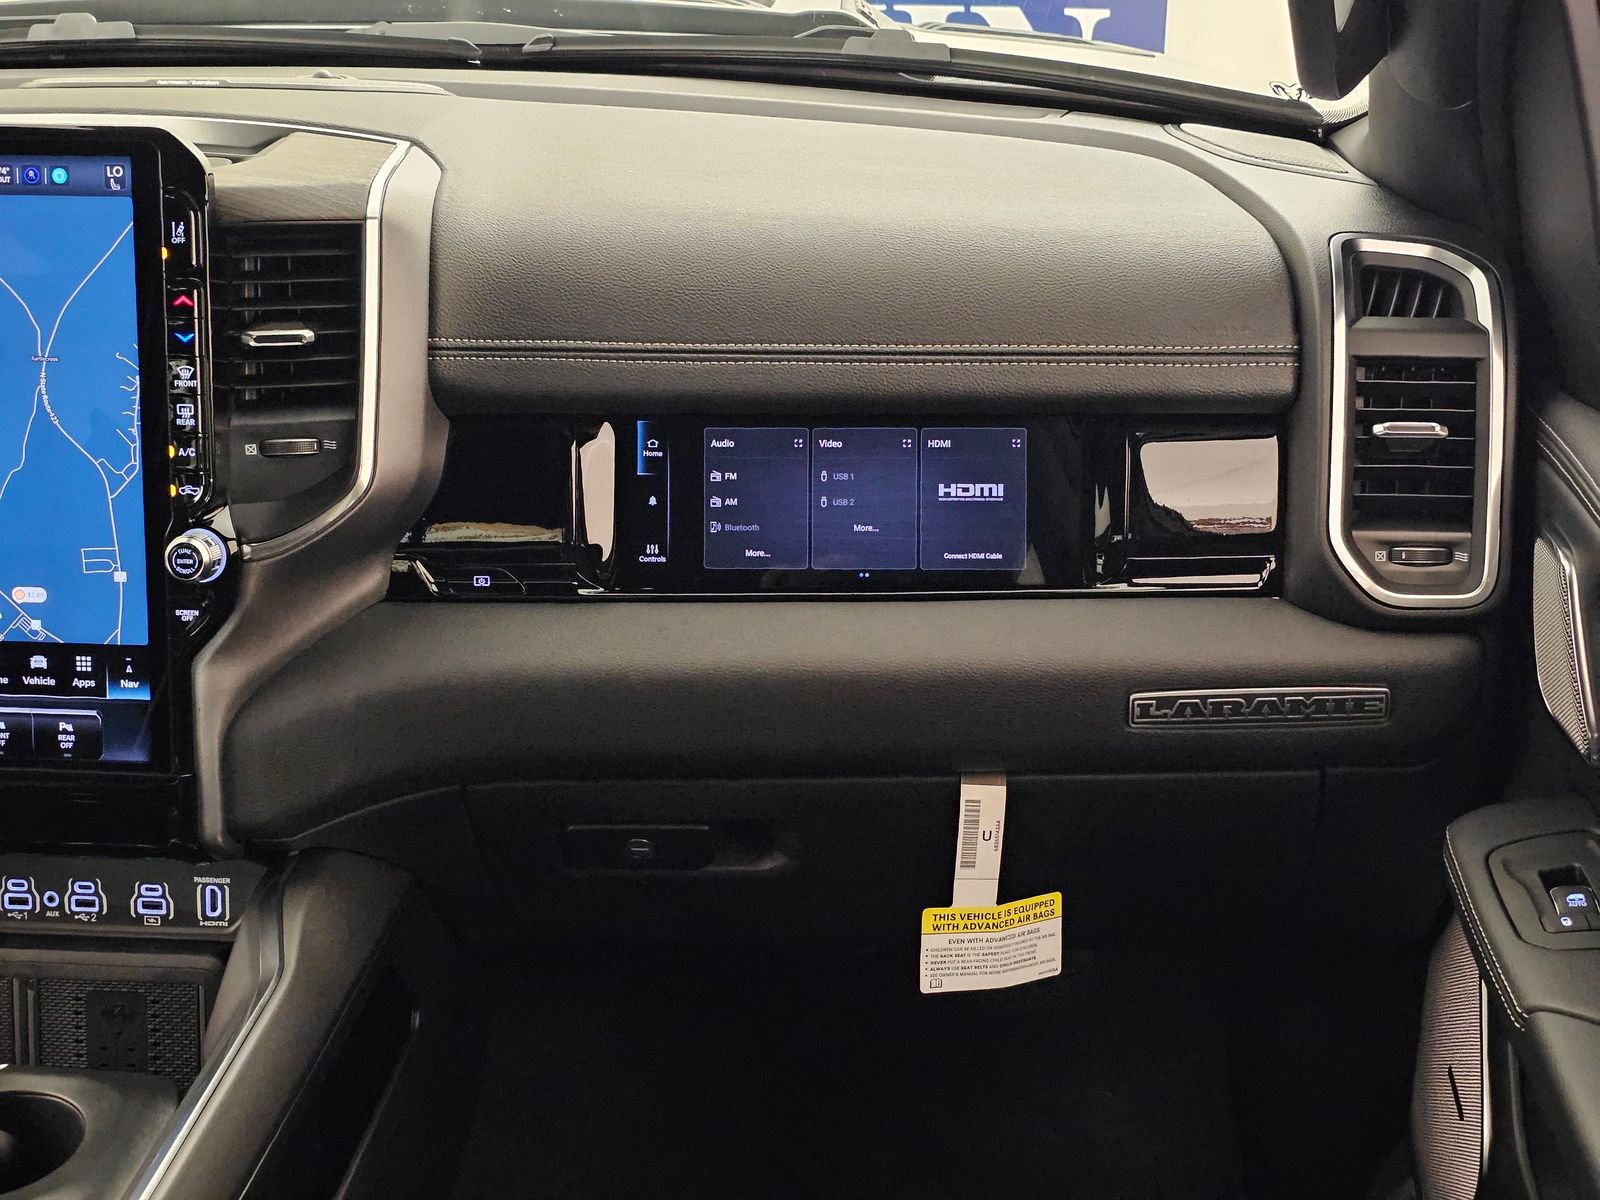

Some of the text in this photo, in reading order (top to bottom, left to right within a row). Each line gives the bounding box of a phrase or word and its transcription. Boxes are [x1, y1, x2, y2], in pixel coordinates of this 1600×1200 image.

[106, 165, 124, 178] LO
[174, 379, 198, 388] FRONT
[176, 418, 196, 426] REAR
[710, 439, 735, 448] Audio
[818, 439, 843, 448] Video
[927, 439, 951, 448] HDMI
[178, 447, 196, 457] A/C
[833, 473, 849, 481] USB
[938, 483, 1004, 497] HDMI
[724, 498, 738, 506] AM
[833, 498, 848, 506] USB
[724, 523, 760, 532] Bluetooth
[853, 524, 880, 532] More...
[745, 549, 771, 557] More...
[943, 552, 1003, 560] Connect HDMI Cable
[639, 555, 667, 563] Controls
[22, 676, 56, 686] Vehicle
[72, 677, 96, 688] Apps
[120, 679, 140, 689] Nav
[1132, 694, 1387, 723] LARAMIE
[58, 734, 76, 742] REAR
[982, 830, 992, 842] U
[193, 876, 231, 884] PASSENGER
[46, 910, 60, 918] AUX
[932, 898, 1056, 921] THIS VEHICLE IS EQUIPPED
[931, 908, 1056, 931] WITH ADVANCED AIR BAGS
